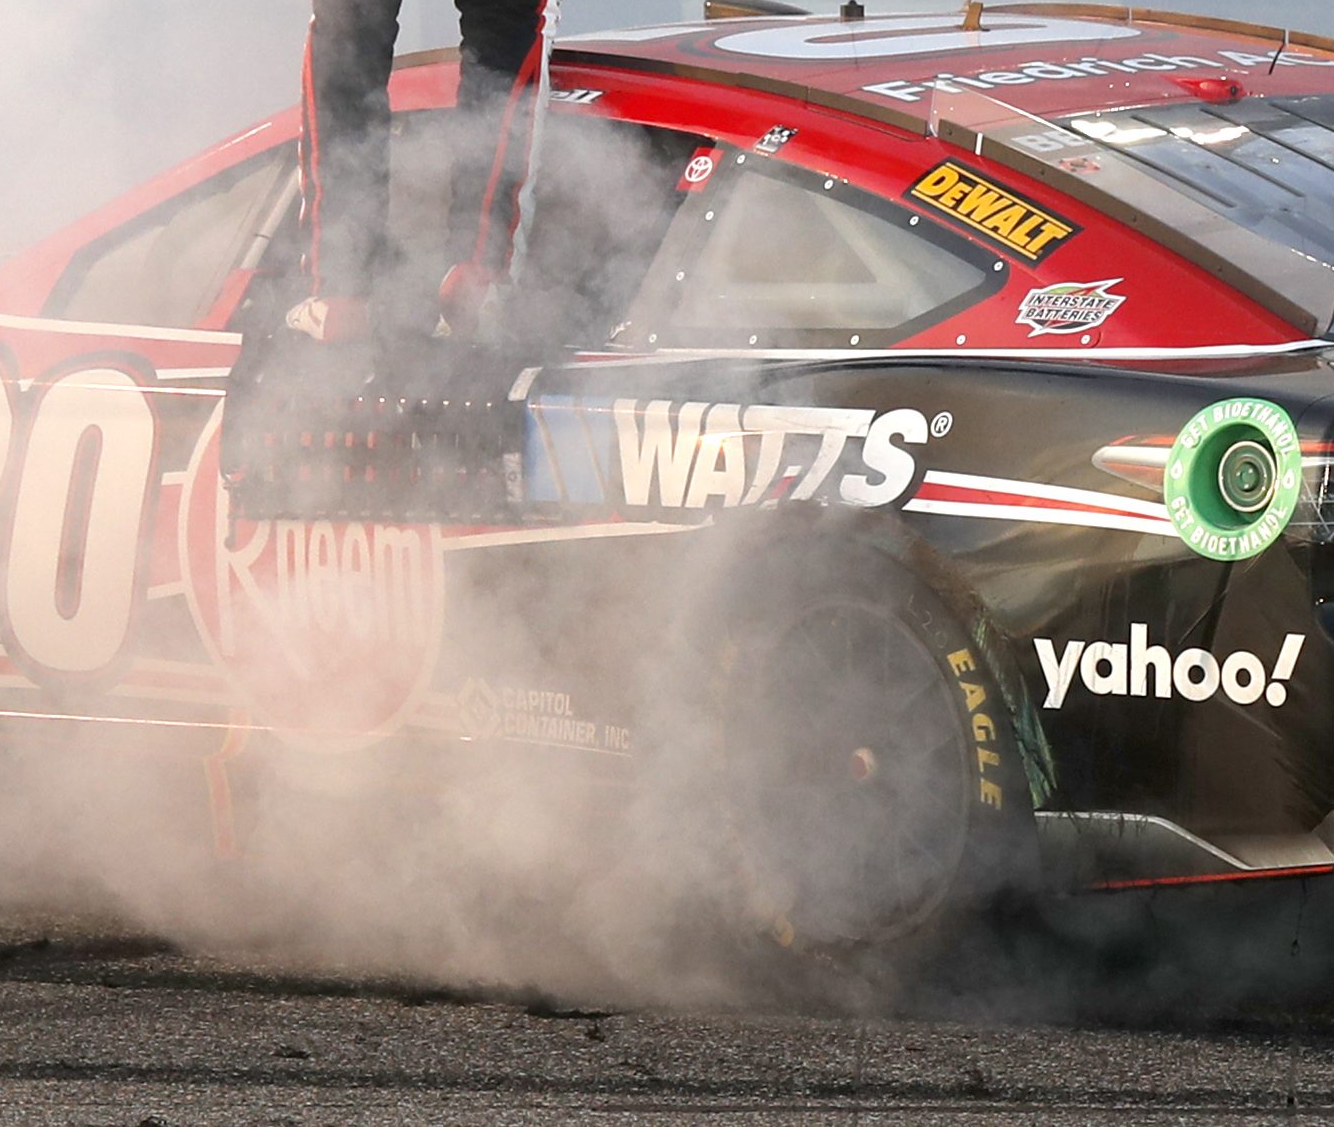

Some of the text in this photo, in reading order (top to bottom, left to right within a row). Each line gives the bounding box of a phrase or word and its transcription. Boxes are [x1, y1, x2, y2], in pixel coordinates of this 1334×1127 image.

[861, 52, 1213, 103] Friedrich
[1025, 306, 1104, 322] BATTERIES
[1028, 293, 1117, 311] INTERSTATE
[1181, 401, 1296, 458] GET BIOETHANOL
[1170, 495, 1289, 555] GET BIOETHANOL
[1032, 622, 1306, 710] yahoo!
[501, 687, 574, 716] CAPITOL
[946, 648, 1002, 811] EAGLE
